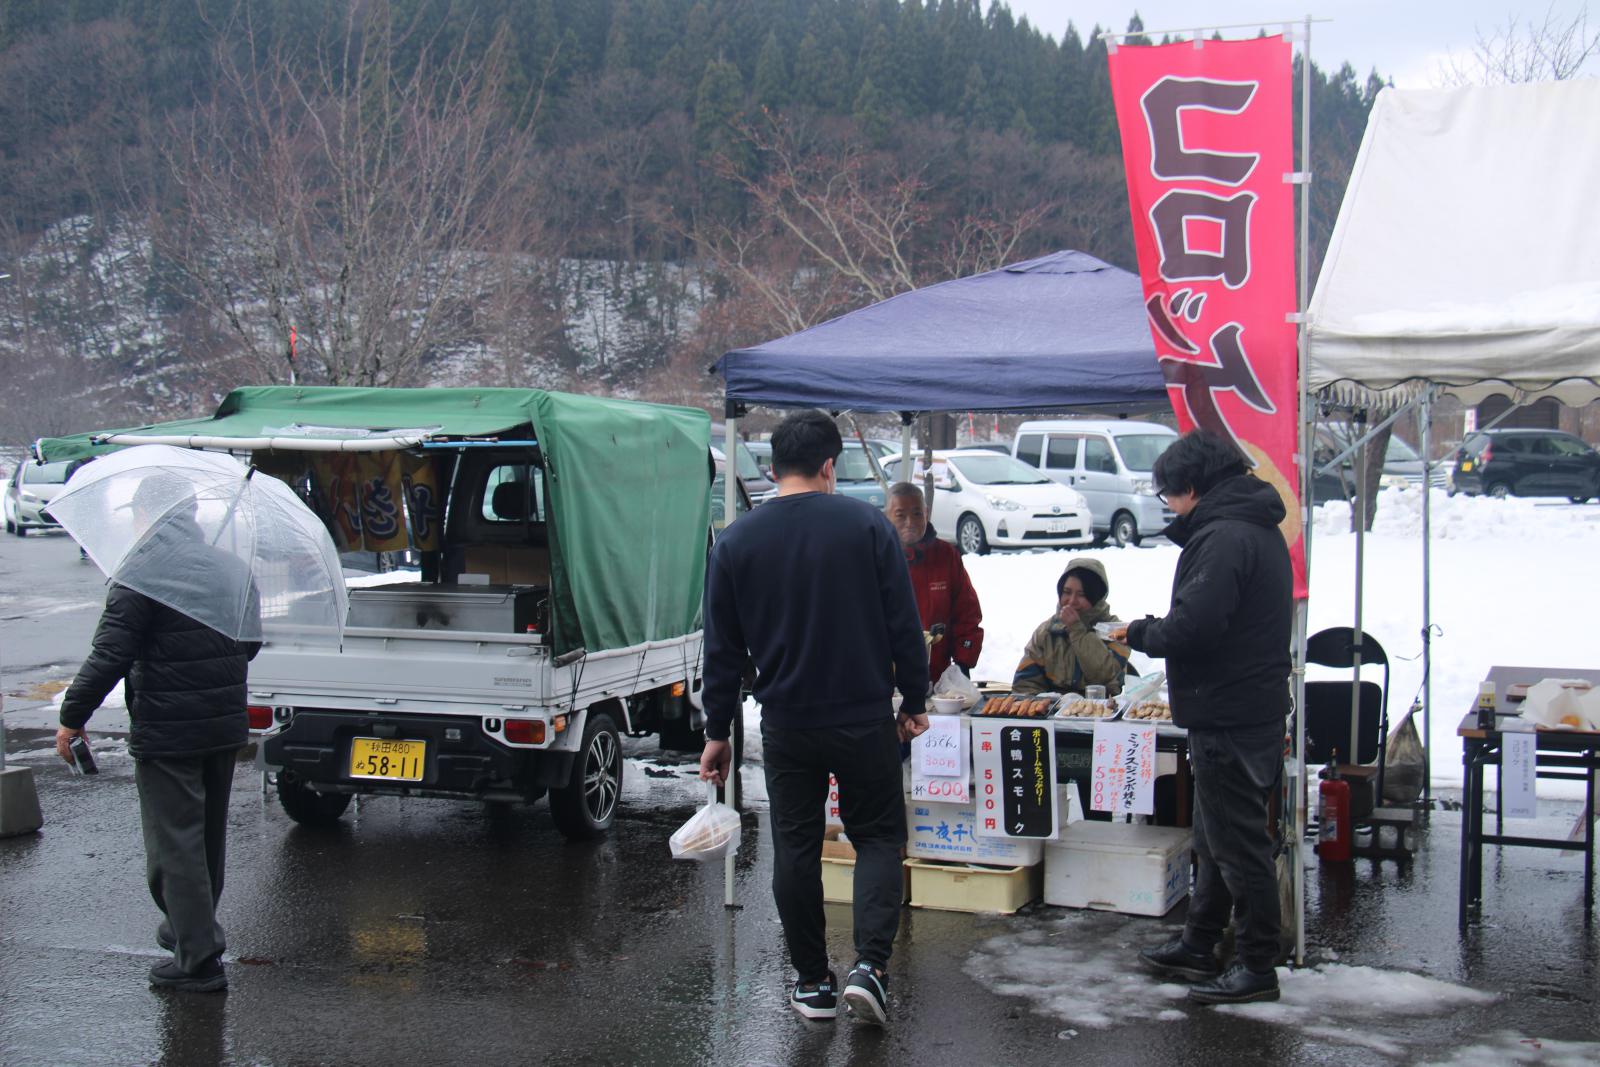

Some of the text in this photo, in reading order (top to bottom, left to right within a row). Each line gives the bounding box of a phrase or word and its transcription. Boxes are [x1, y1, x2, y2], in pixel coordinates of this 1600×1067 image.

[371, 742, 410, 754] 秋田480
[367, 755, 418, 778] 58-11
[980, 731, 996, 830] 一串 500円
[1010, 729, 1025, 834] 合鴨スモーク
[914, 820, 977, 844] 一夜干し
